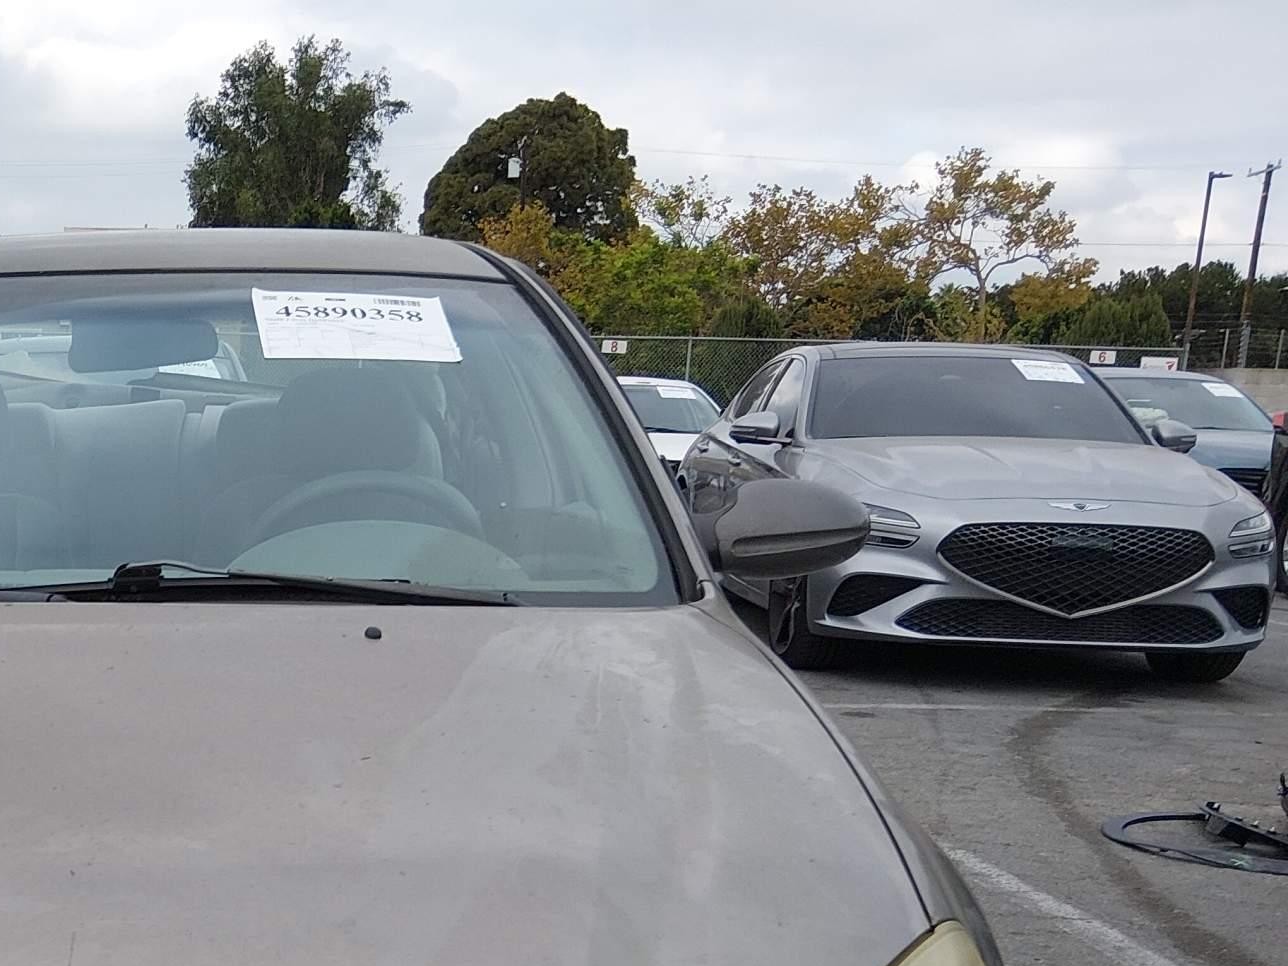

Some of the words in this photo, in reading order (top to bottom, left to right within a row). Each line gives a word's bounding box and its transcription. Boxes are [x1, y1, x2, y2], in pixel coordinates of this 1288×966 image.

[274, 305, 424, 323] 45890358
[610, 340, 618, 353] 8
[1097, 351, 1107, 363] 6
